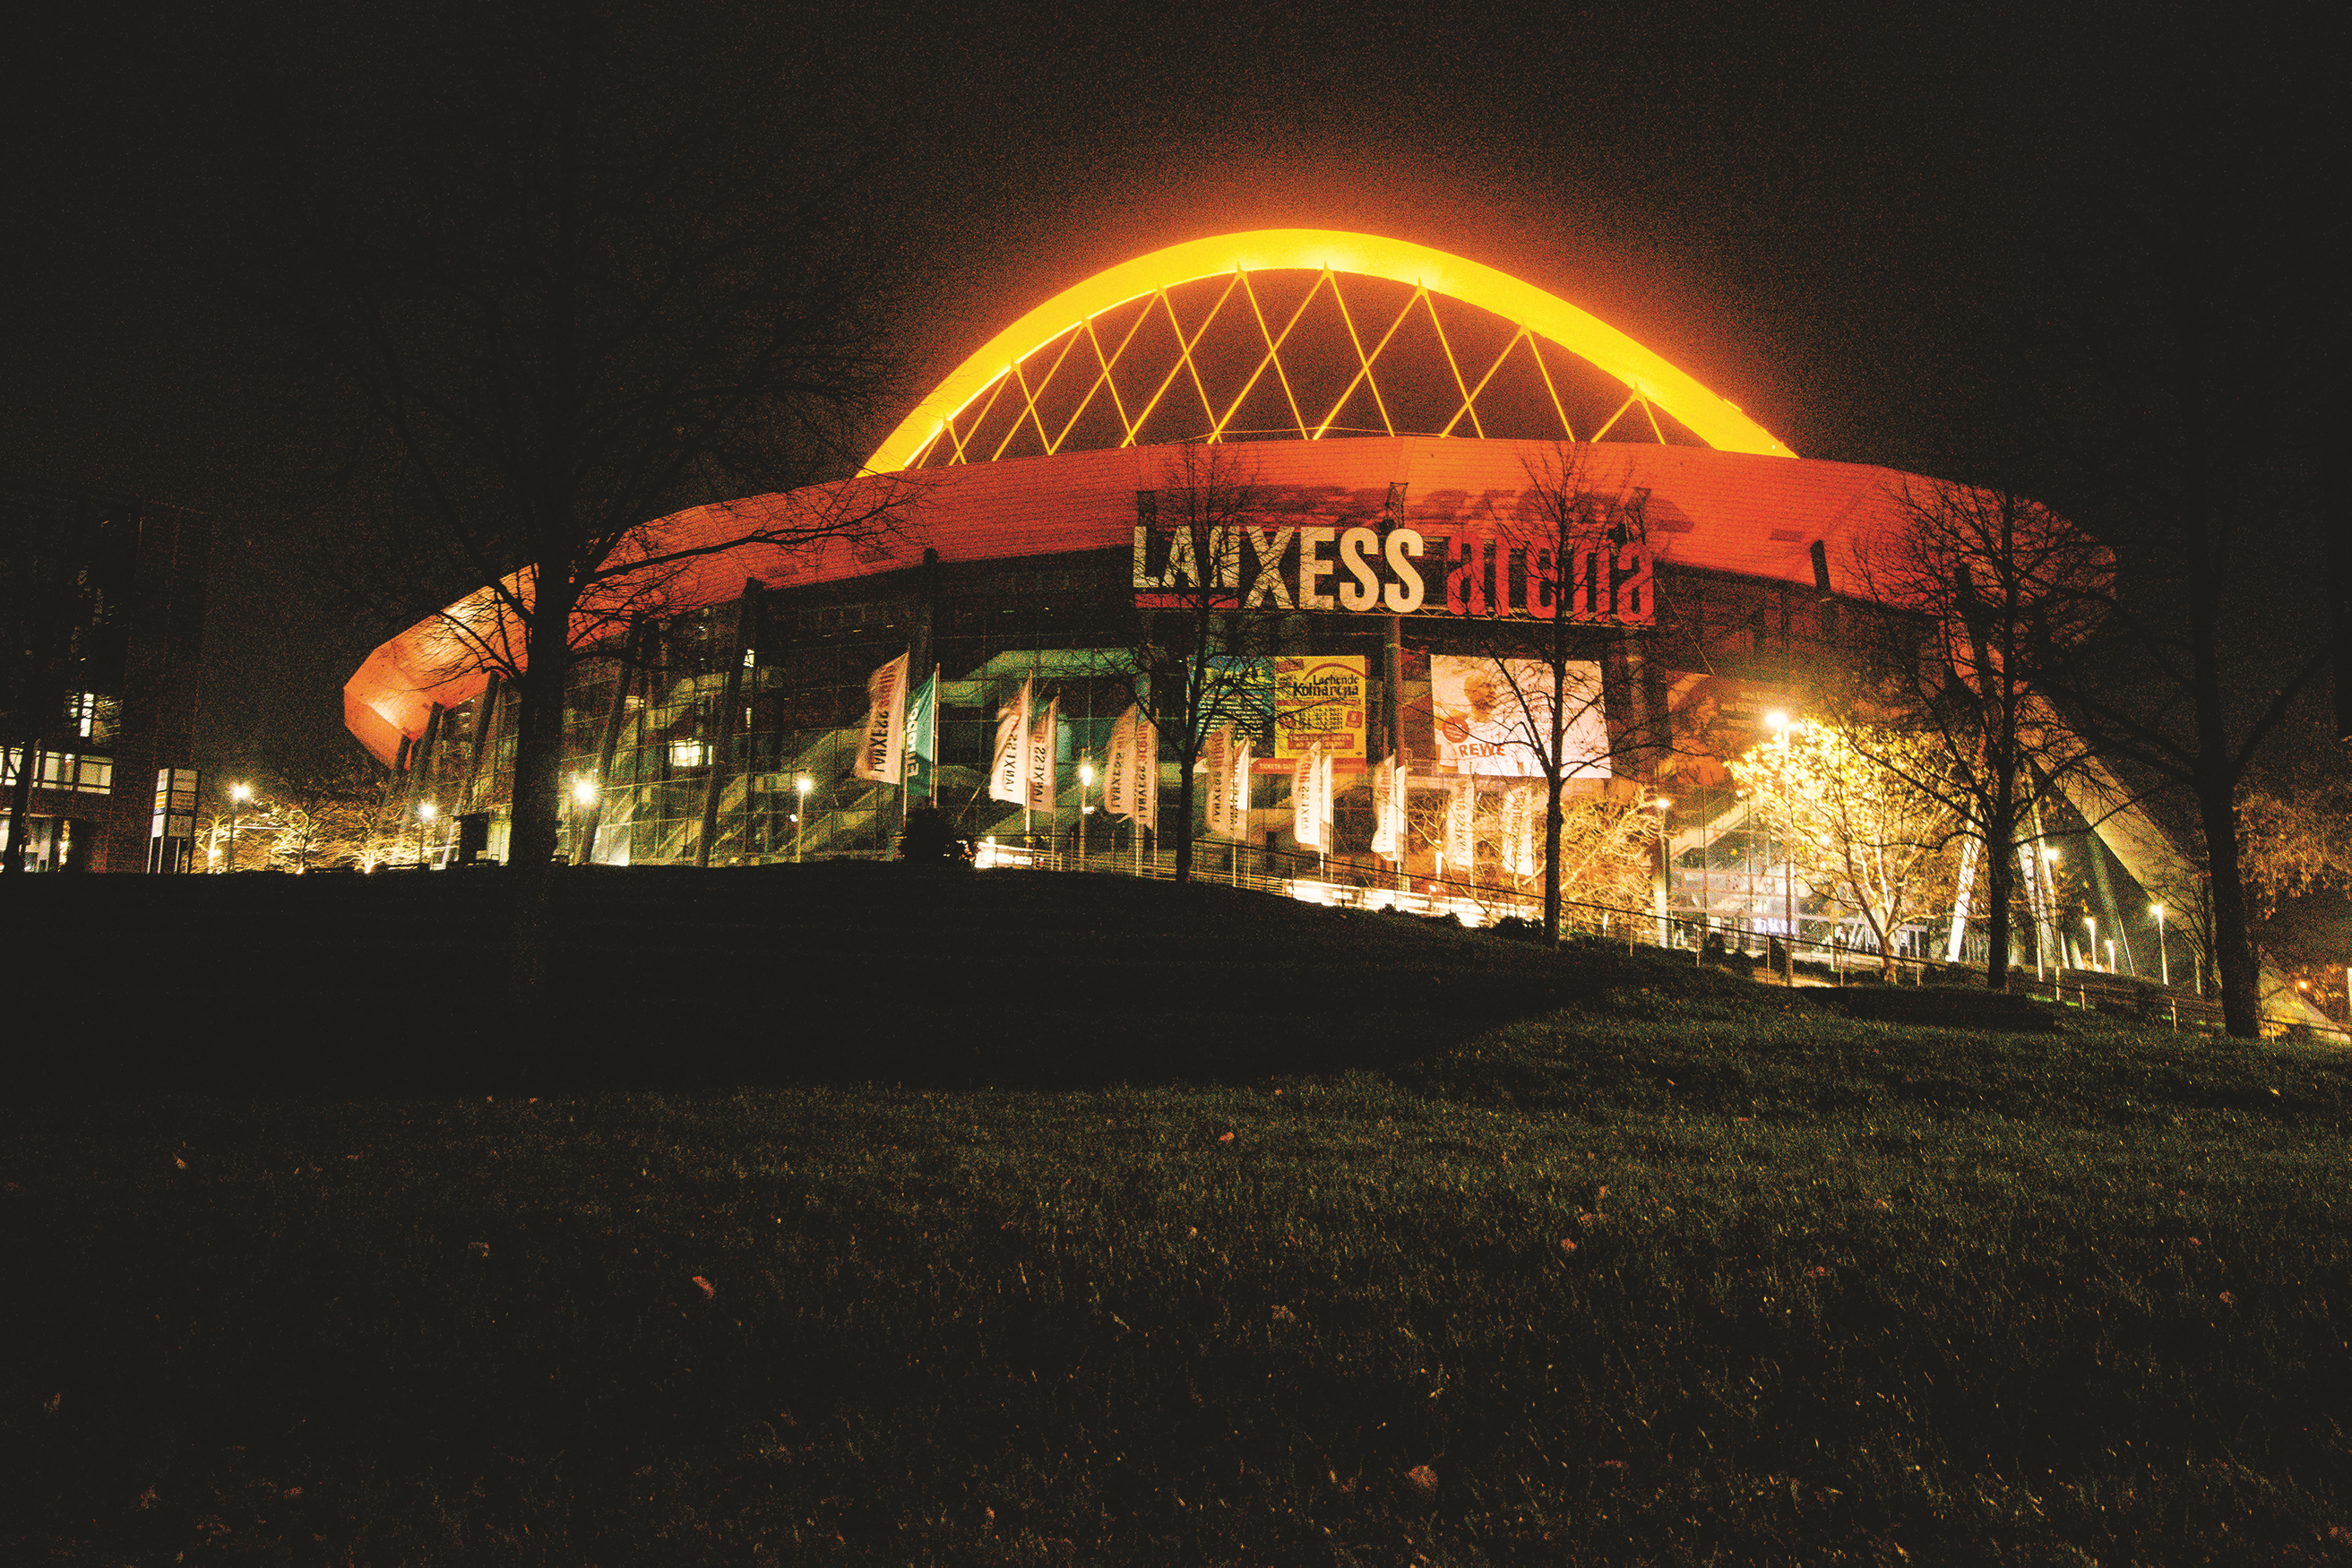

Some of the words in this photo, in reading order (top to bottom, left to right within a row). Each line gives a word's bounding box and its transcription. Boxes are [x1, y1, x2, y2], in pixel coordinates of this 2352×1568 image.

[1133, 525, 1425, 613] LANXESS
[1446, 531, 1656, 625] arena
[1458, 743, 1505, 757] REWE
